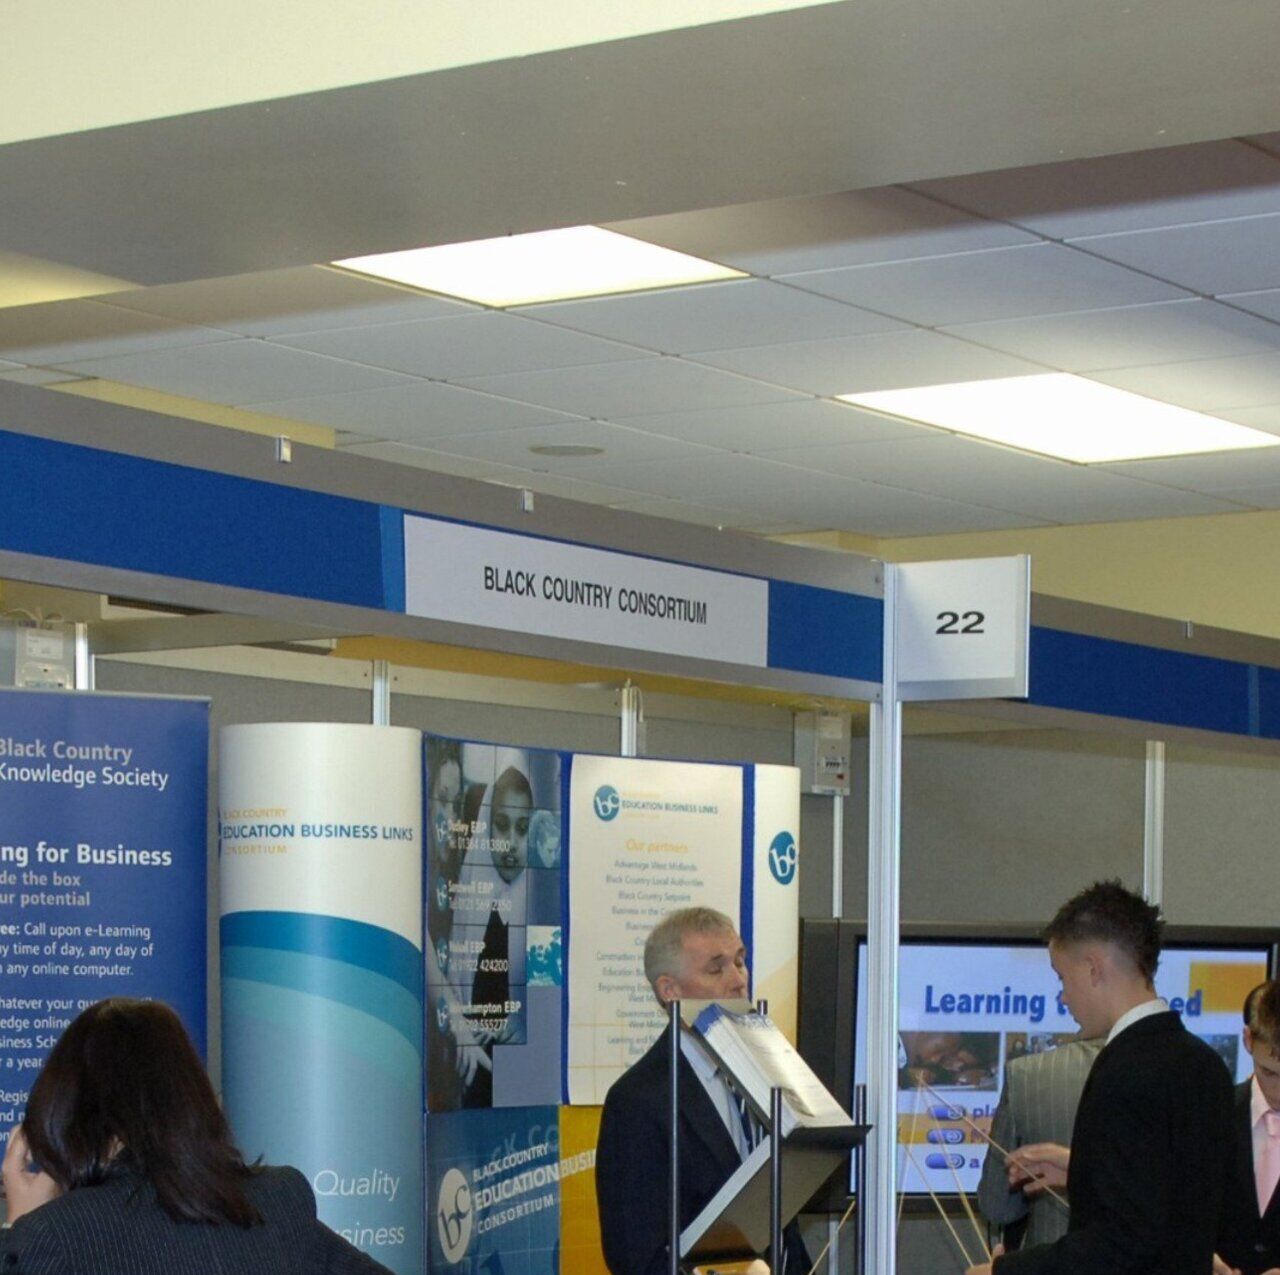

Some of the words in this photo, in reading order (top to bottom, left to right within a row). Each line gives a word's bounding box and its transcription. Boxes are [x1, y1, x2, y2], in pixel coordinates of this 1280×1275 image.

[484, 566, 535, 597] BLACK
[542, 575, 612, 610] COUNTRY
[618, 590, 707, 625] CONSORTIUM
[936, 611, 985, 634] 22
[53, 740, 133, 766] Country
[102, 766, 169, 792] Society
[622, 800, 663, 811] EDUCATION
[664, 802, 698, 813] BUSINESS
[699, 804, 718, 815] LINKS
[223, 823, 295, 839] EDUCATION
[301, 823, 378, 839] BUSINESS
[382, 826, 413, 841] LINKS
[470, 821, 488, 833] EBP
[36, 842, 68, 863] for
[77, 844, 173, 866] Business
[22, 871, 48, 886] the
[52, 872, 81, 886] box
[478, 881, 494, 894] EBP
[20, 892, 91, 908] potential
[24, 922, 46, 935] Call
[50, 926, 81, 939] upon
[85, 924, 151, 940] e-Learning
[13, 942, 40, 955] time
[44, 942, 56, 955] of
[61, 943, 85, 958] day,
[89, 945, 111, 958] any
[115, 944, 137, 959] day
[141, 943, 154, 957] of
[470, 941, 486, 953] EBP
[7, 964, 28, 978] any
[32, 961, 70, 975] online
[73, 963, 134, 979] computer.
[47, 999, 73, 1012] your
[504, 1001, 522, 1013] EBP
[925, 985, 1046, 1023] Learning
[33, 1016, 70, 1029] online
[6, 1058, 14, 1068] a
[473, 1160, 501, 1183] BLACK
[502, 1142, 549, 1169] COUNTRY
[314, 1168, 401, 1202] Quality
[474, 1162, 560, 1211] EDUCATION
[477, 1194, 554, 1234] CONSORTIUM
